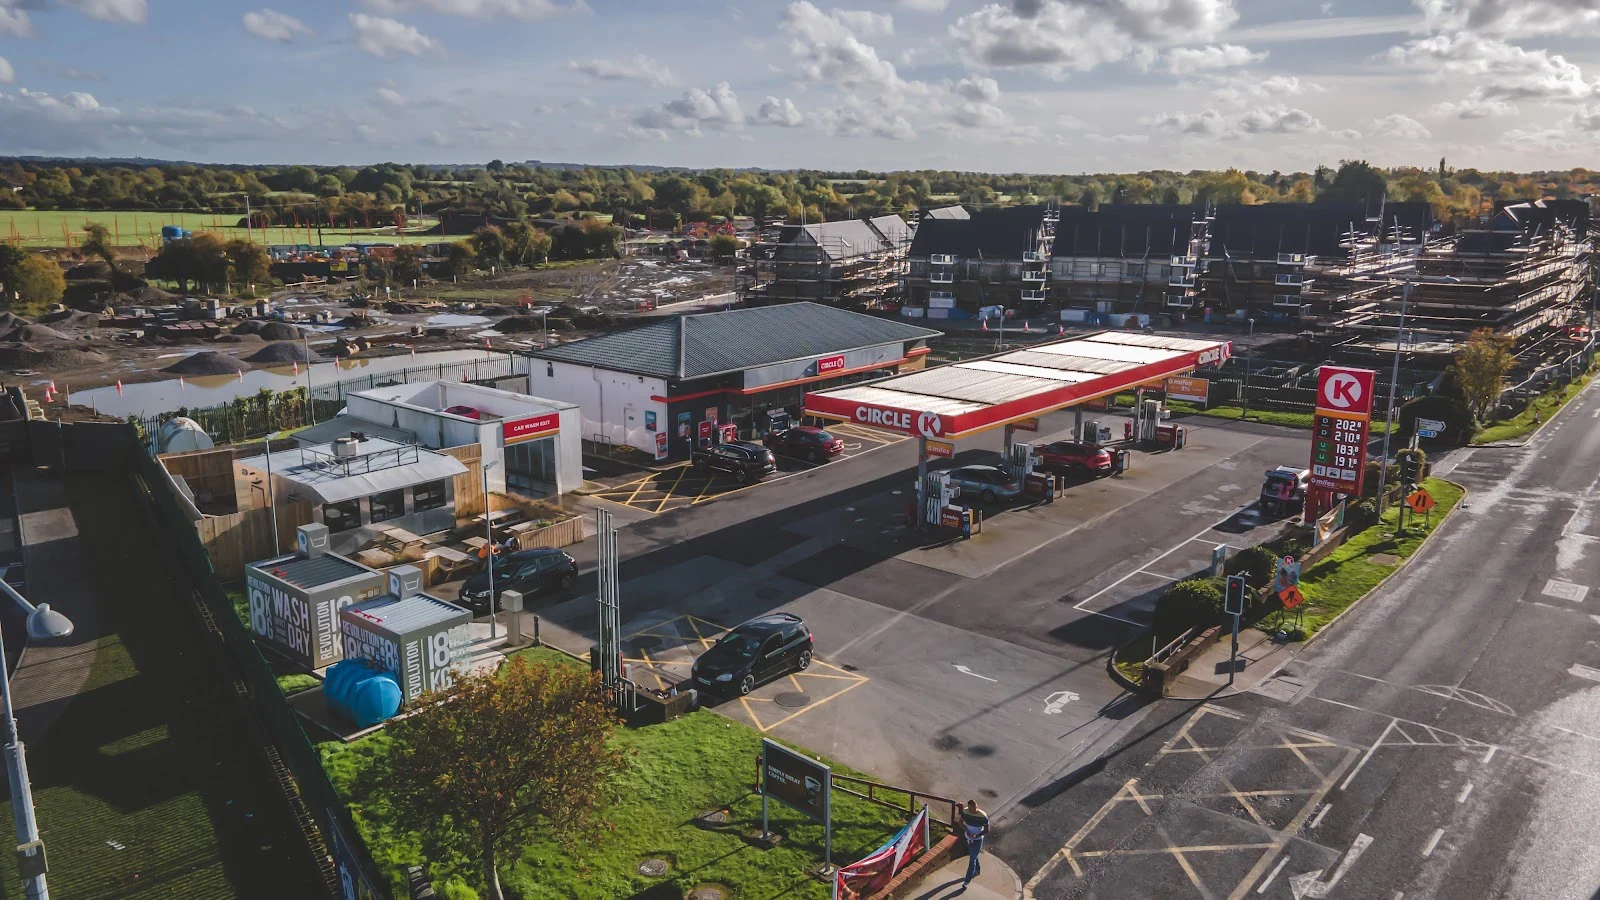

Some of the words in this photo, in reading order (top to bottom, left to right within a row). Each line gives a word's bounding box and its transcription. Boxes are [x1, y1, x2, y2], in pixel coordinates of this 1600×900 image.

[821, 361, 837, 369] CIRCLE
[1330, 377, 1359, 406] K
[513, 424, 524, 432] CAR
[540, 419, 551, 427] EXIT
[855, 406, 911, 429] CIRCLE
[921, 414, 940, 438] K
[272, 587, 310, 631] WASH
[288, 622, 310, 656] DRY
[317, 600, 333, 660] REVOLUTION
[428, 631, 450, 670] 18
[430, 666, 452, 693] KG
[785, 773, 800, 785] GREAT
